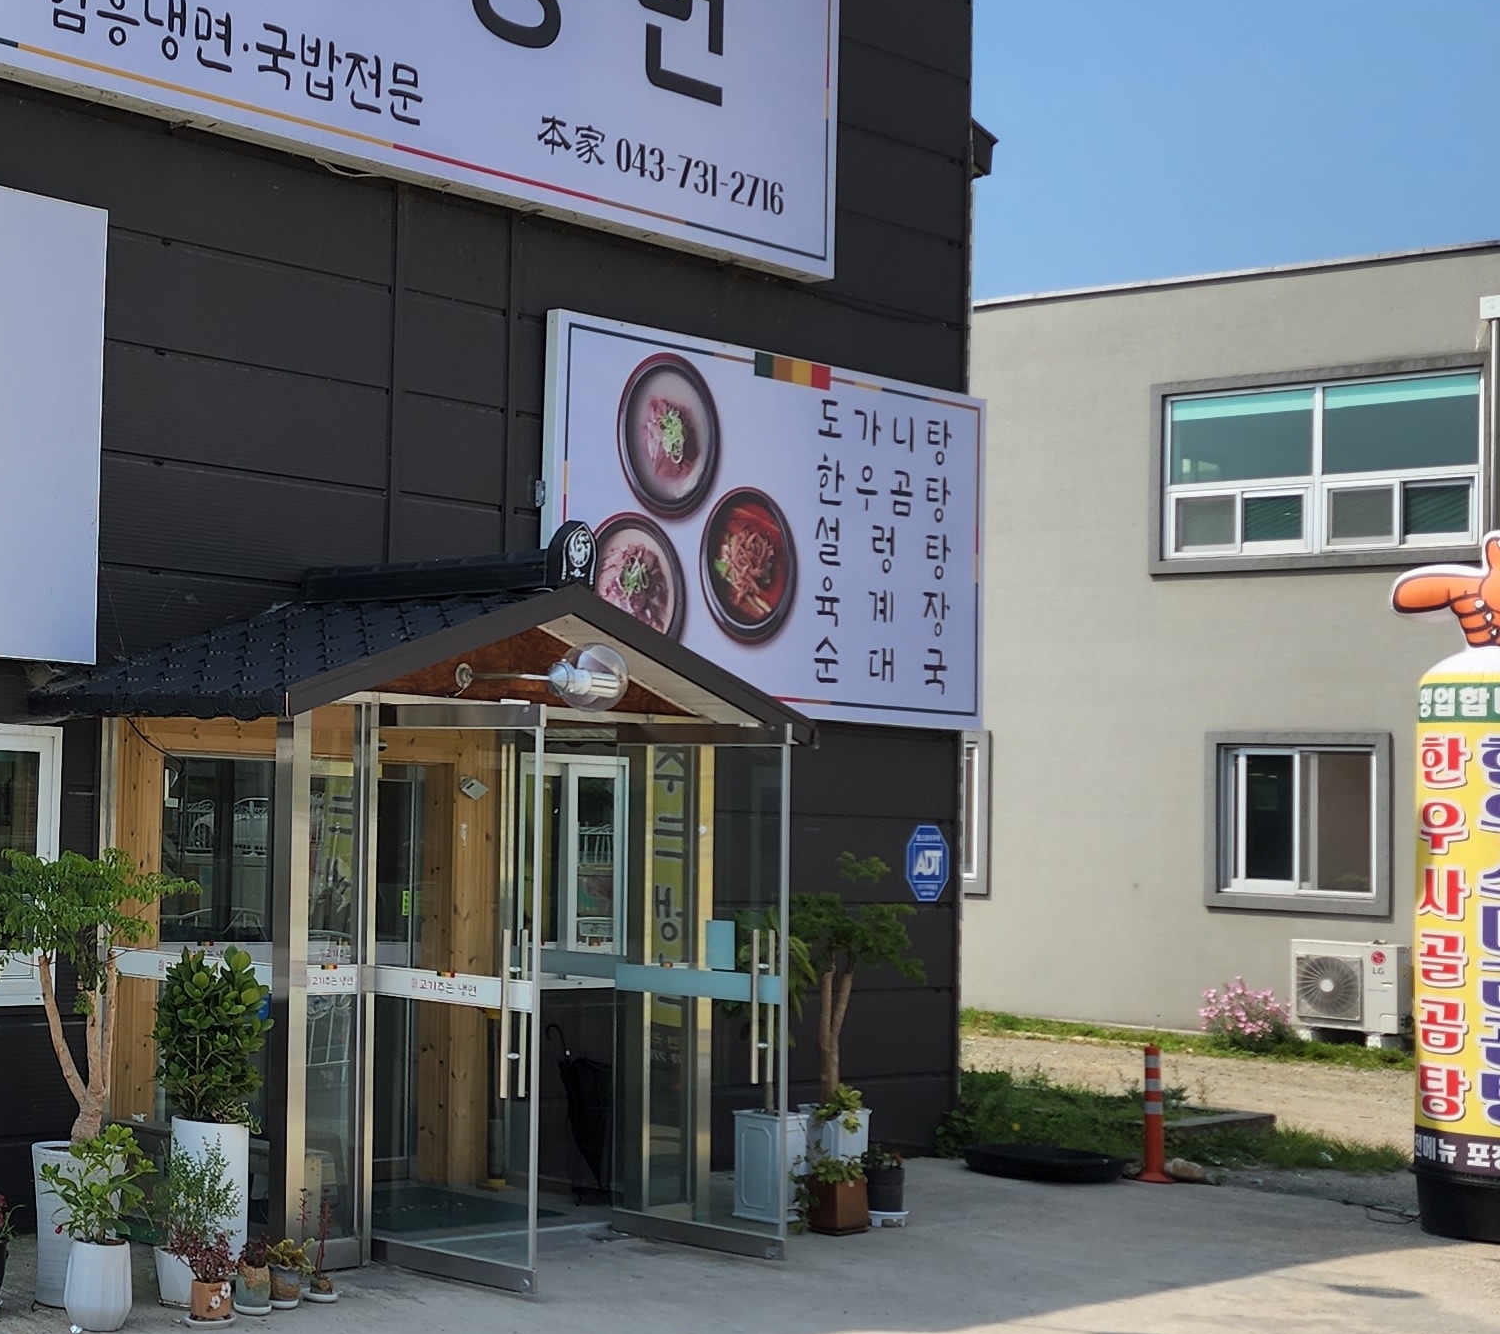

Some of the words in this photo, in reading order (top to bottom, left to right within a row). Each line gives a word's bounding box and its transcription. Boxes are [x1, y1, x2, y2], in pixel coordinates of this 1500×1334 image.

[538, 115, 605, 165] 本家
[616, 138, 784, 216] 043-731-2716
[818, 399, 952, 466] 도가니탕
[817, 453, 951, 523] 한우곰탕
[815, 516, 951, 580] 설렁탕
[815, 576, 950, 637] 육계장
[814, 636, 948, 695] 순대국
[1420, 687, 1500, 718] 영업합
[913, 850, 942, 875] ADT
[1419, 735, 1470, 1120] 한우사골곰탕
[419, 979, 455, 995] 고기주는
[1372, 967, 1385, 975] LG
